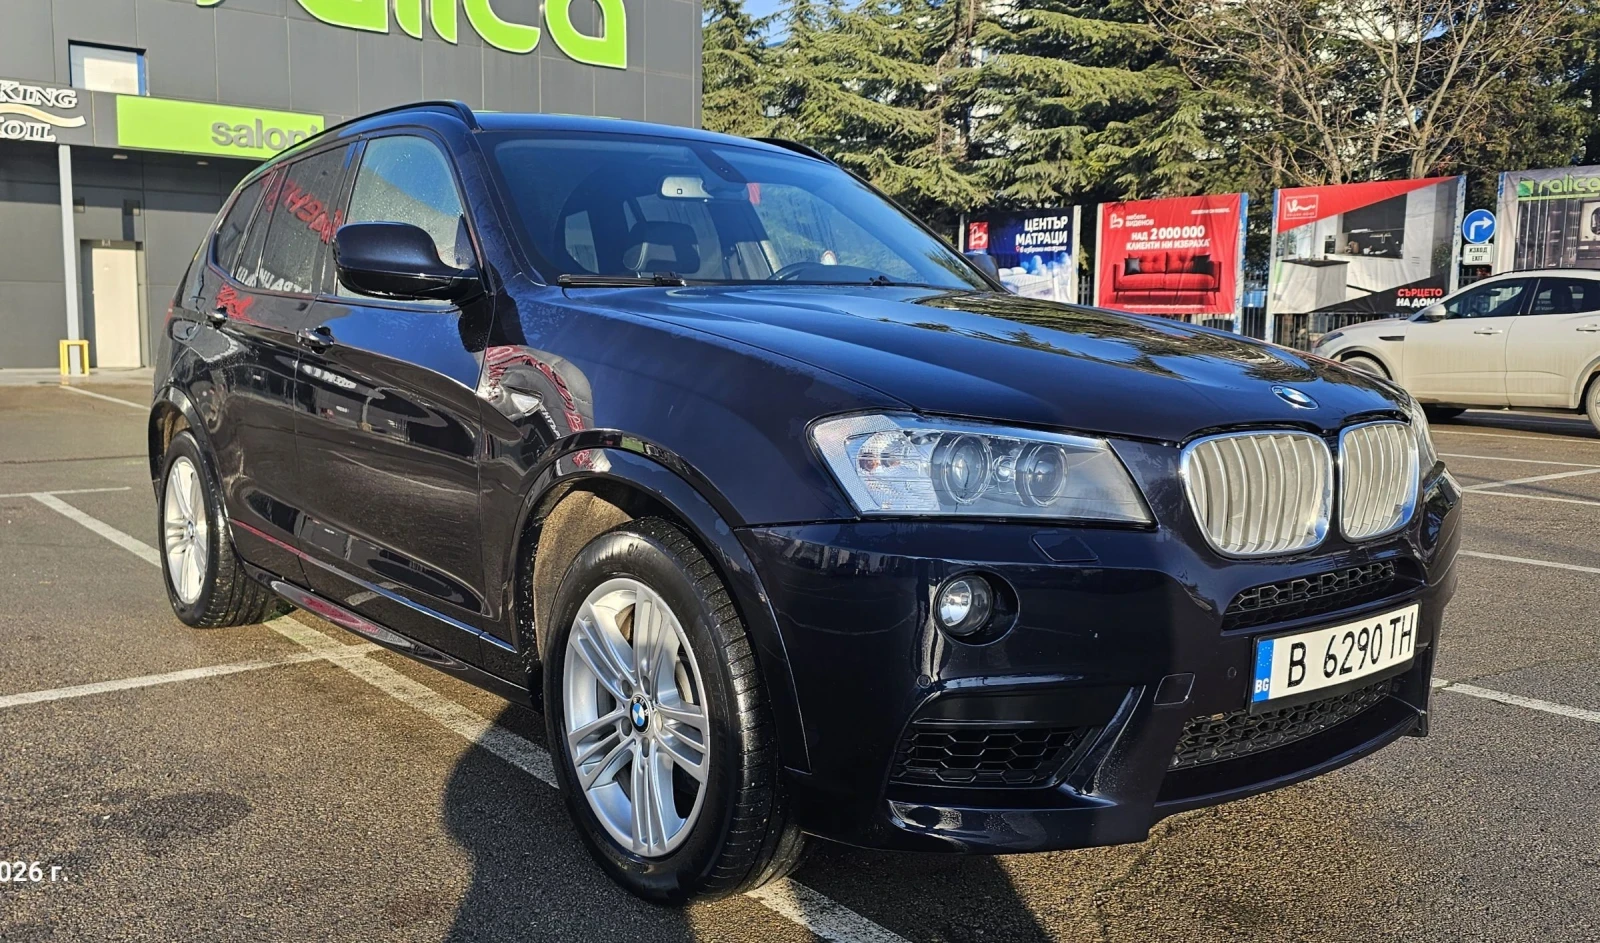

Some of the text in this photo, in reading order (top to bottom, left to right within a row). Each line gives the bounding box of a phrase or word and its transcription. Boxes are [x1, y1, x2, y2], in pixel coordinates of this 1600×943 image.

[1024, 216, 1069, 232] ЦЕНТЪР
[1015, 231, 1068, 246] МАТРАЦИ
[1131, 232, 1149, 241] НАД
[1125, 241, 1161, 251] КЛИЕНТИ
[1161, 240, 1173, 249] НИ
[1397, 288, 1443, 298] СЪРЦЕТО
[1396, 297, 1411, 307] НА
[1287, 612, 1415, 688] B 6290 TH
[1254, 678, 1270, 693] BG
